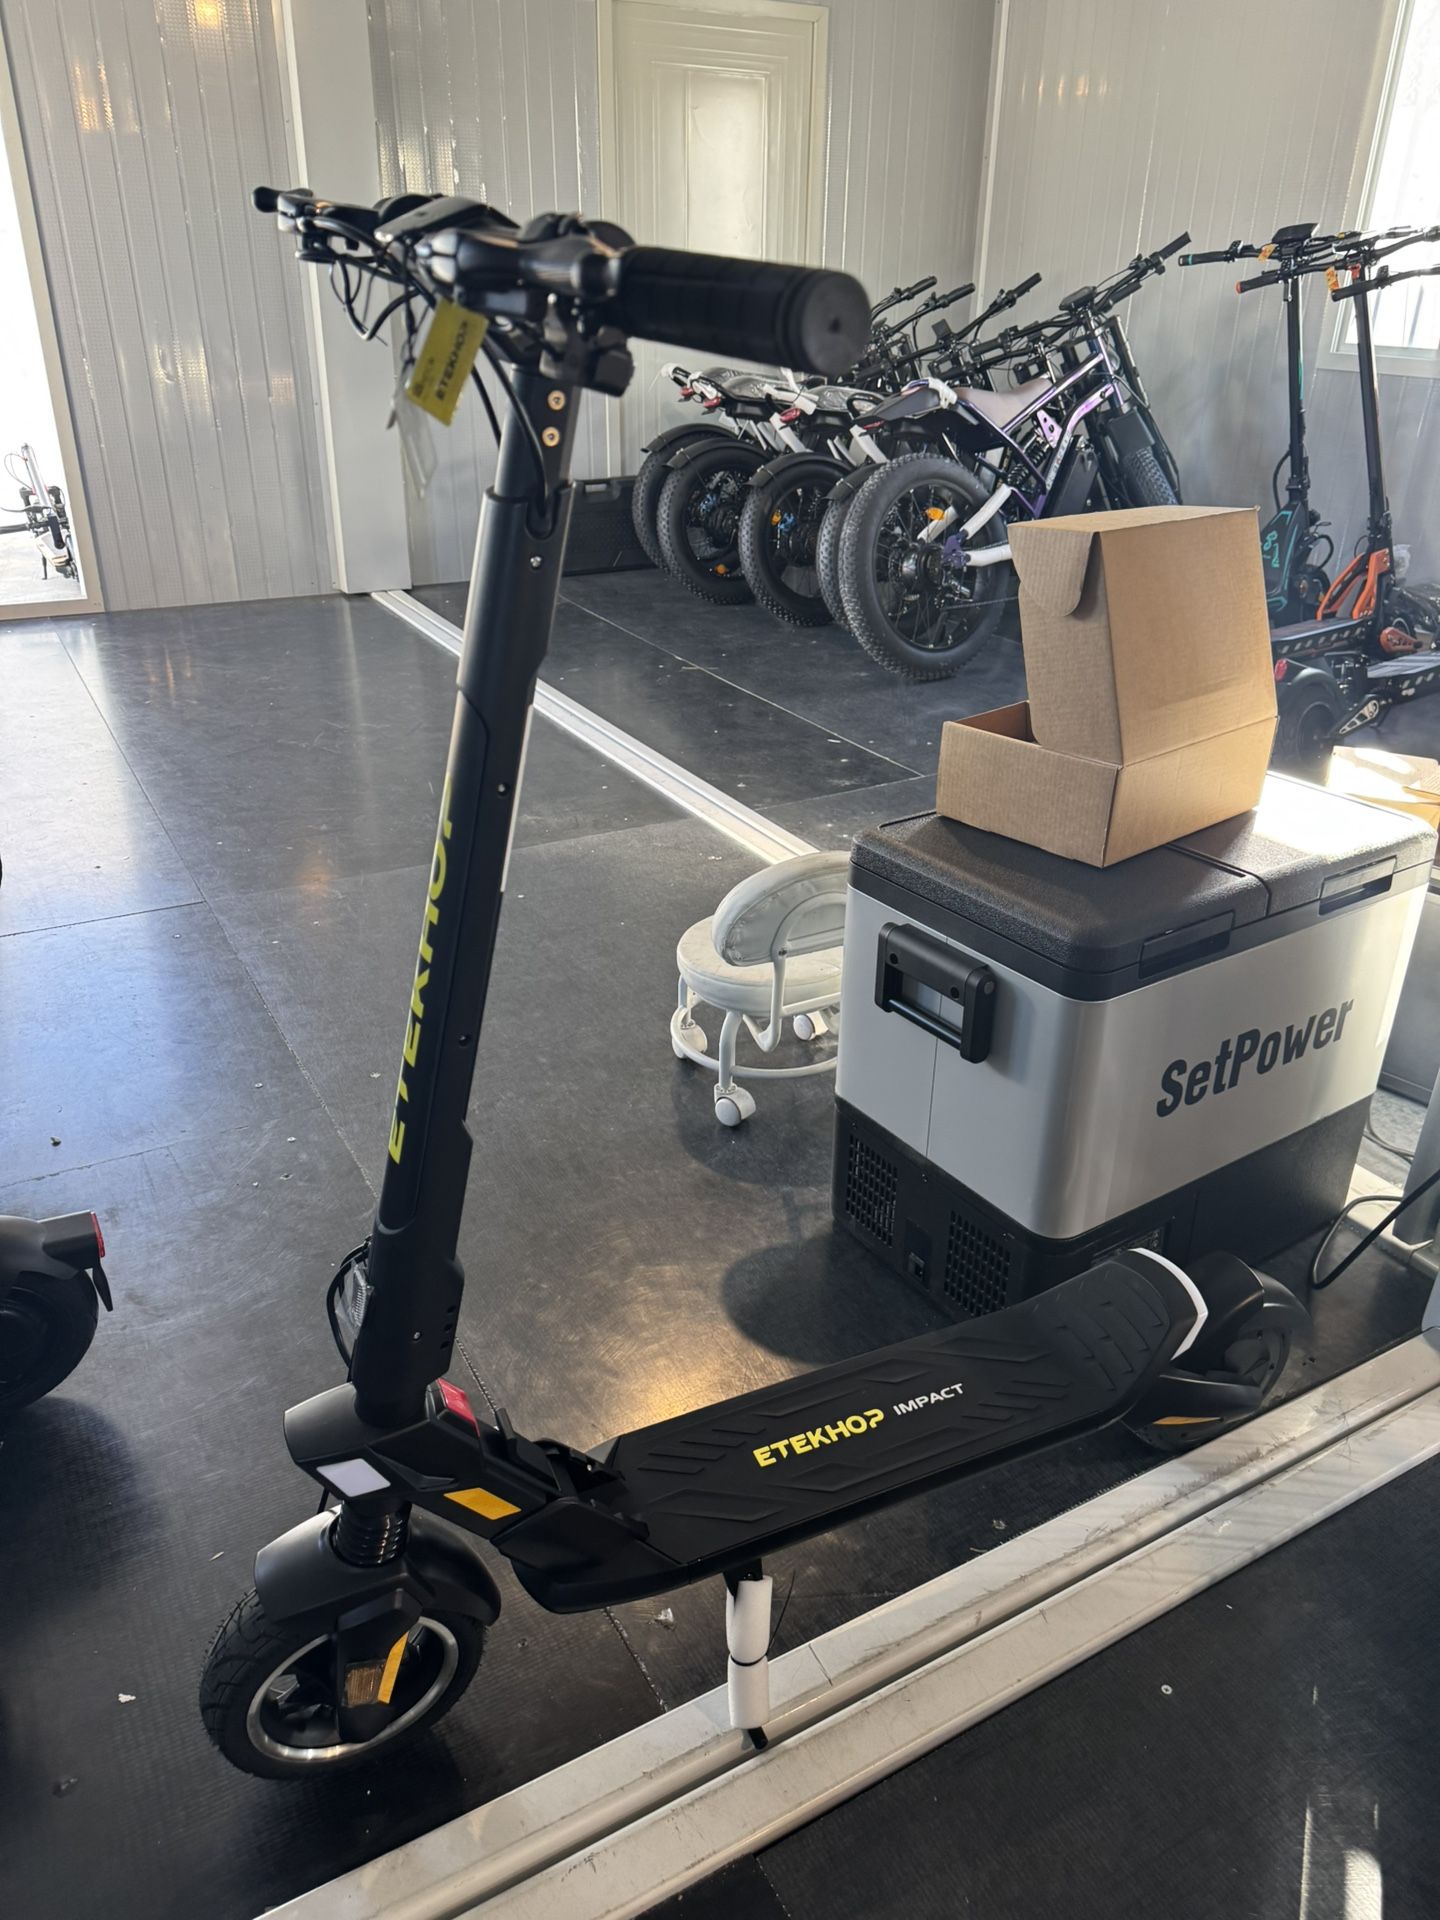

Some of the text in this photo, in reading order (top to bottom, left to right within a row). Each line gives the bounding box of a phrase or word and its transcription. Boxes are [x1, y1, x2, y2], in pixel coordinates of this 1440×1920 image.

[1156, 999, 1354, 1118] SetPower
[752, 1383, 964, 1468] ETEKHOP IMPACT
